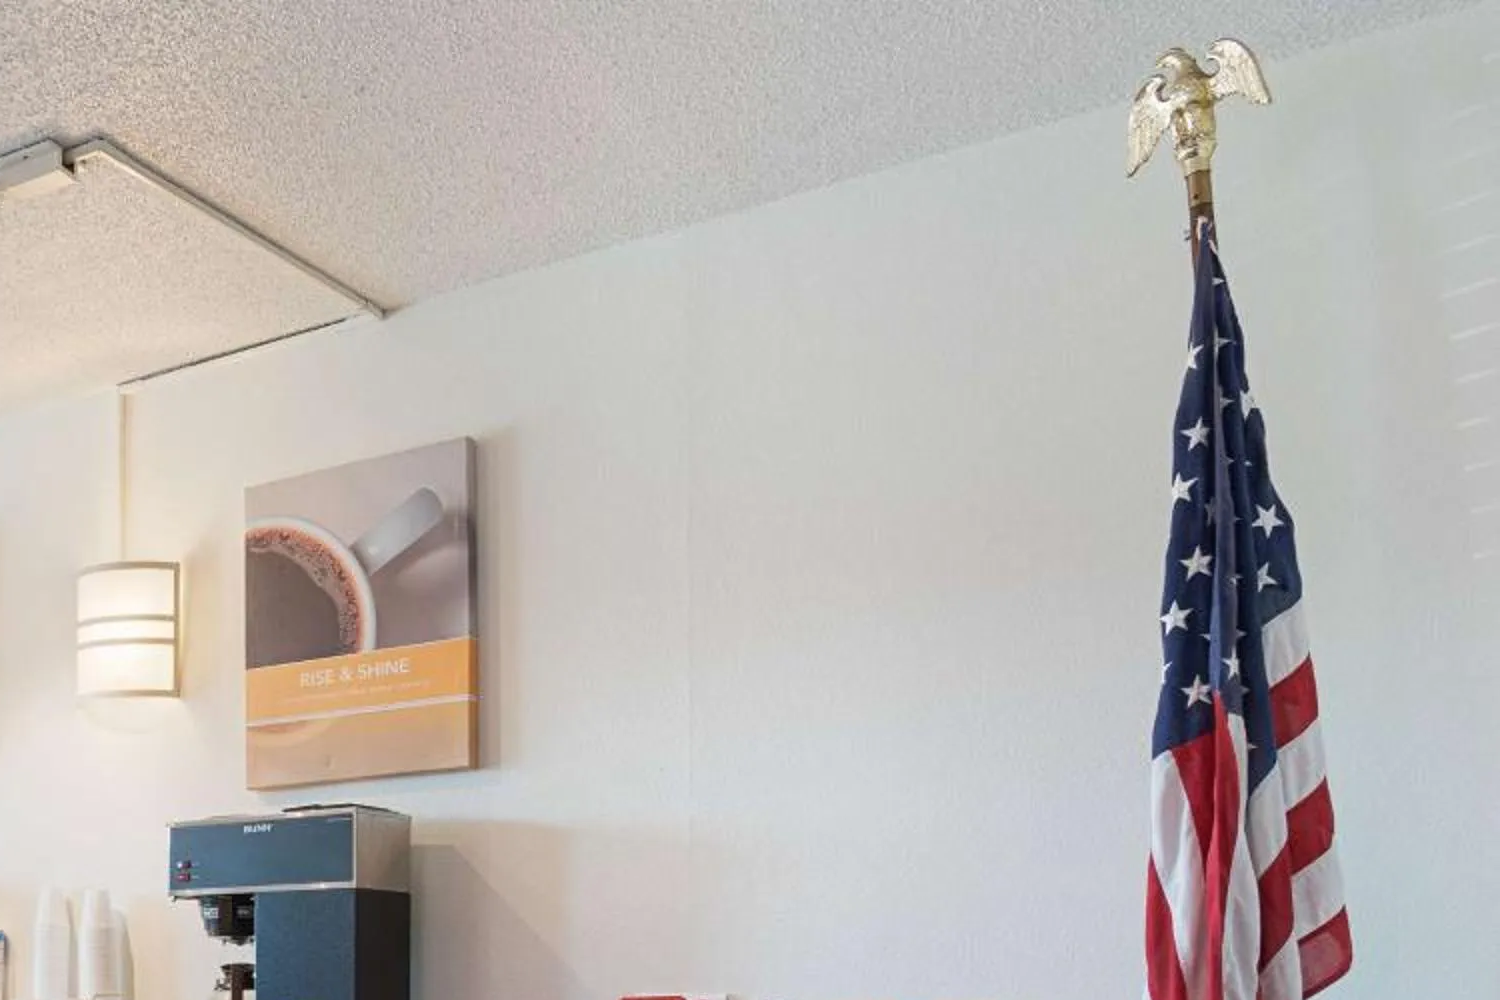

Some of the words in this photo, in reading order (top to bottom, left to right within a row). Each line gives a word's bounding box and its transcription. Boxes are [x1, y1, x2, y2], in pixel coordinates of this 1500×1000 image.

[300, 669, 335, 688] RISE
[339, 667, 354, 683] &
[357, 657, 411, 681] SHINE
